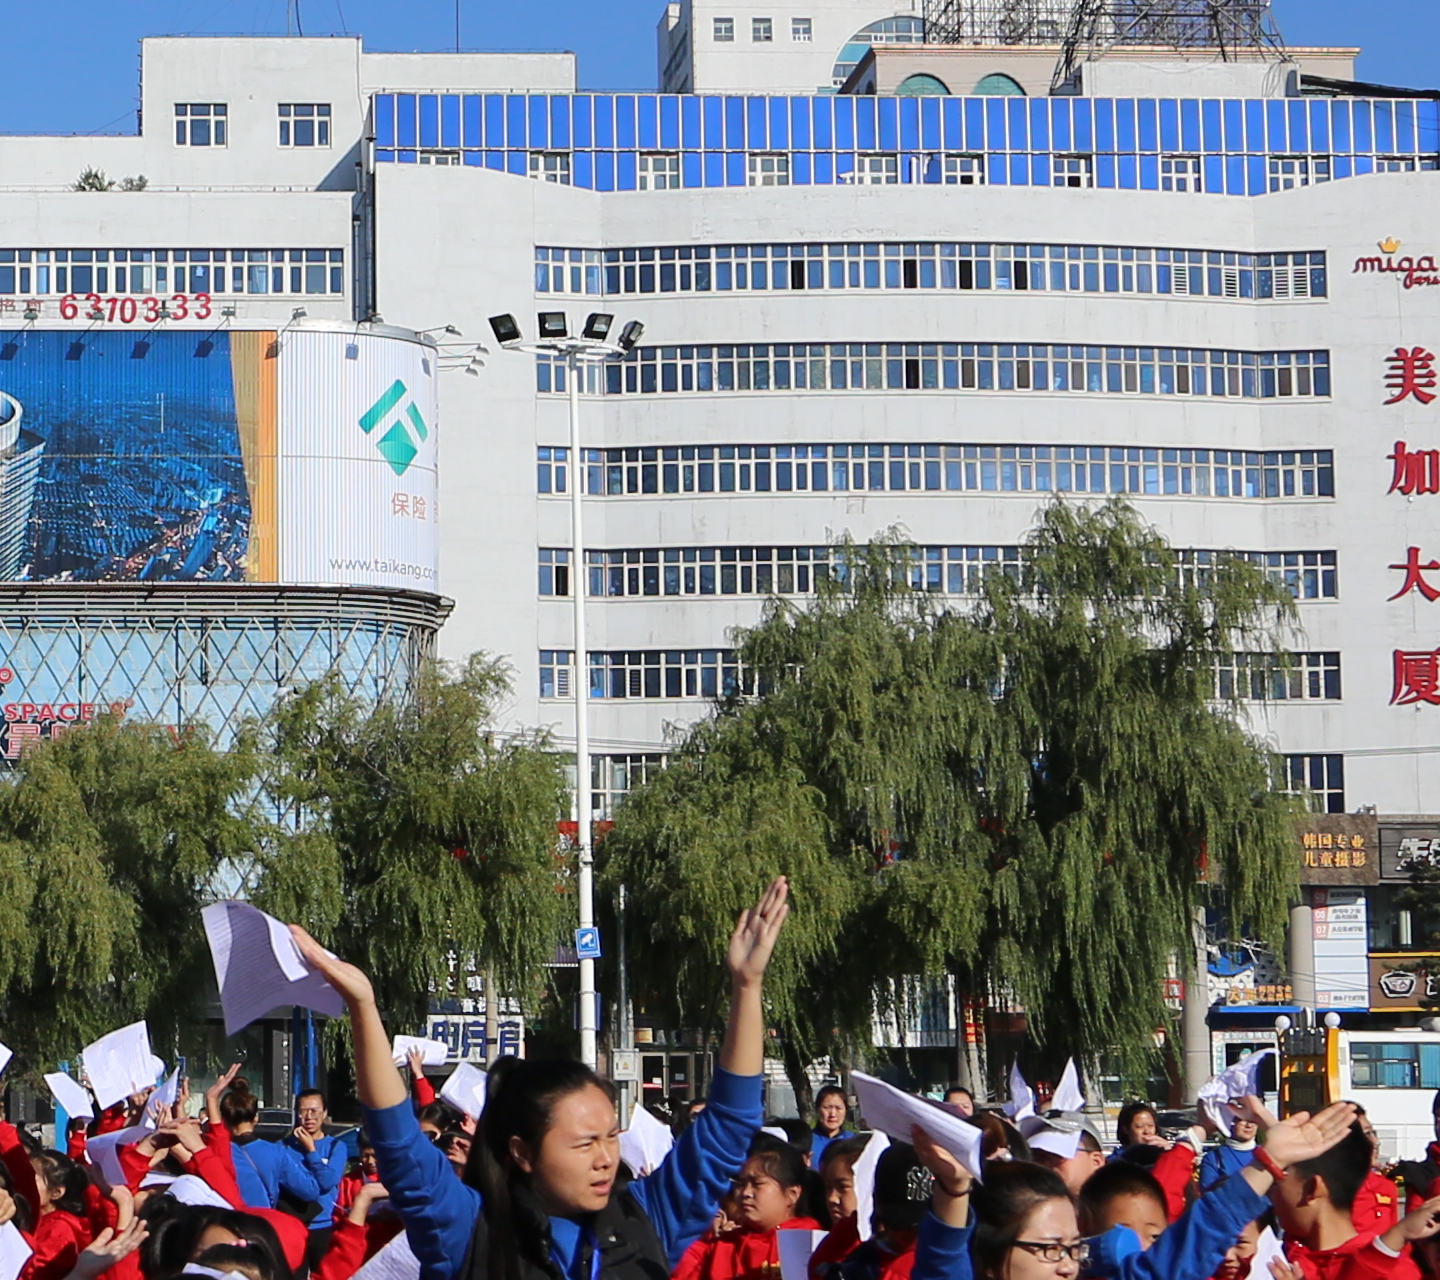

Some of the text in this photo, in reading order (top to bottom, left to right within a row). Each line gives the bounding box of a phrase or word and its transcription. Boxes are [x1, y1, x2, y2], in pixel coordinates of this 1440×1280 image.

[4, 703, 93, 721] SPACE
[1302, 833, 1366, 849] 韩国专业
[1302, 851, 1366, 868] 儿童摄影
